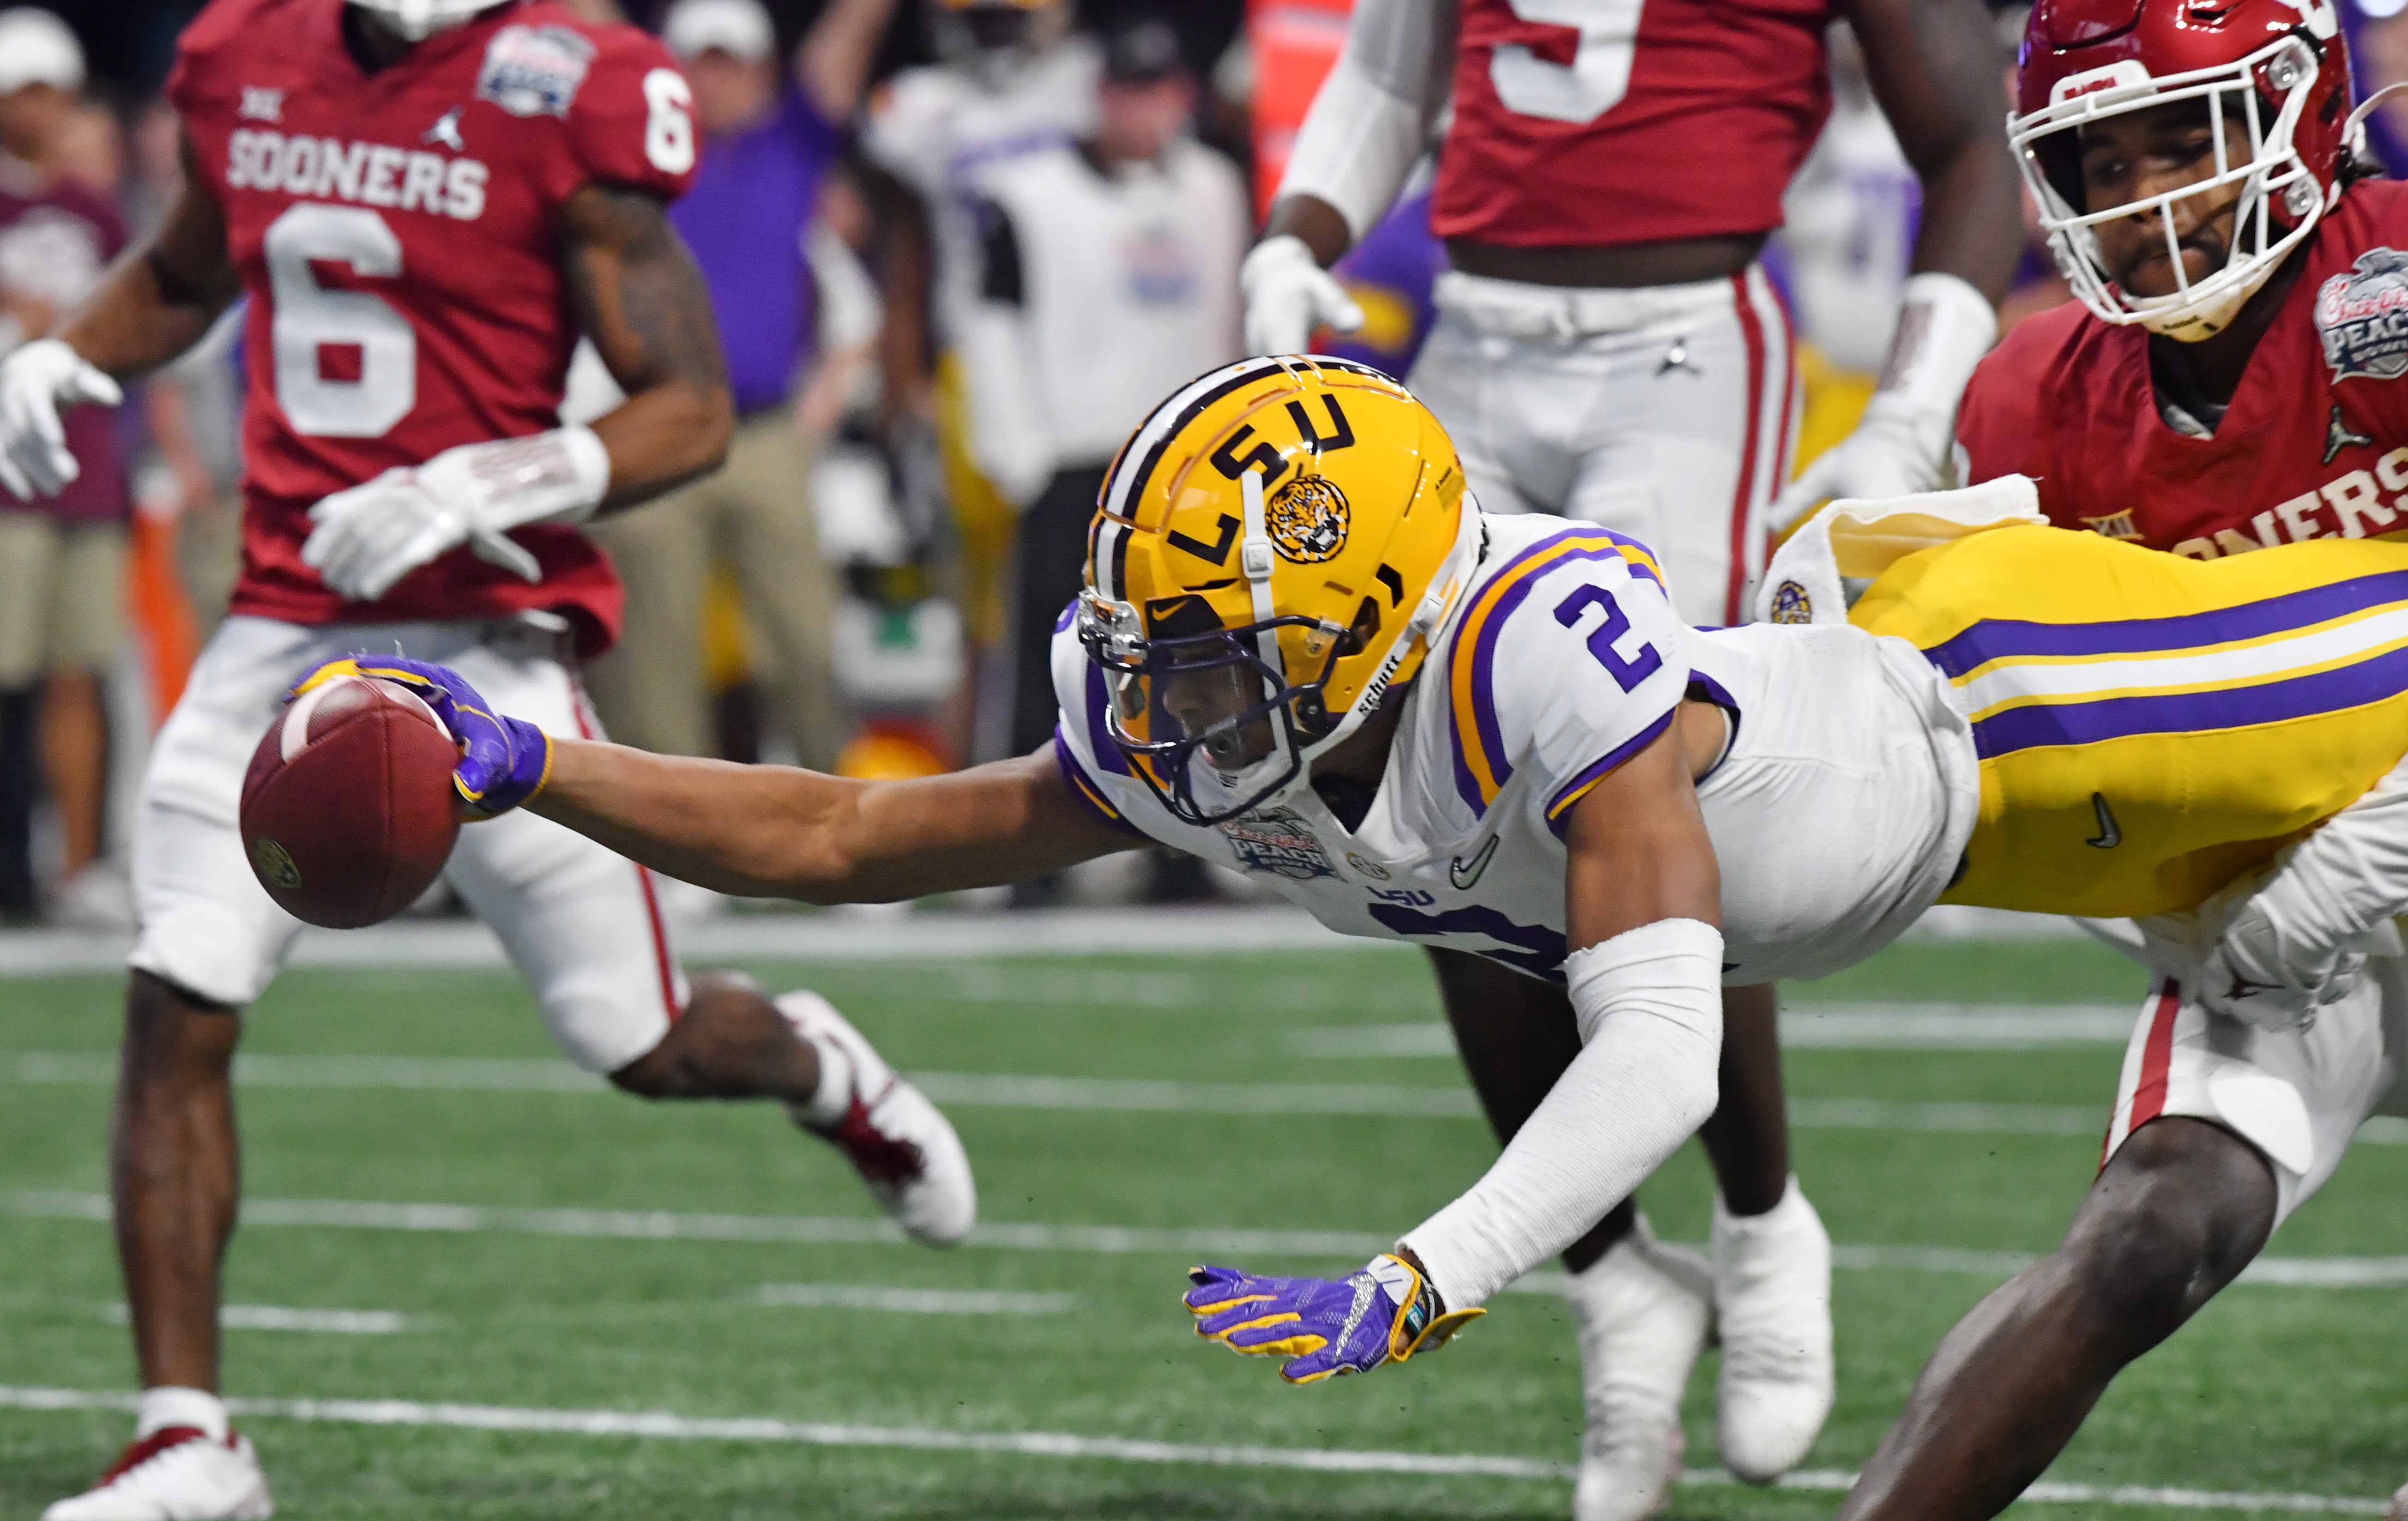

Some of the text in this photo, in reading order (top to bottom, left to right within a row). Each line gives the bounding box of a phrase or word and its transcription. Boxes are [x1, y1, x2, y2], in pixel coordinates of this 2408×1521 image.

[227, 128, 489, 221] SOONERS
[643, 68, 695, 175] 6
[263, 200, 417, 438] 6
[2322, 311, 2408, 361] PEAC
[1167, 394, 1355, 567] LSU
[1553, 583, 1663, 694] 2
[1365, 885, 1436, 906] LSU
